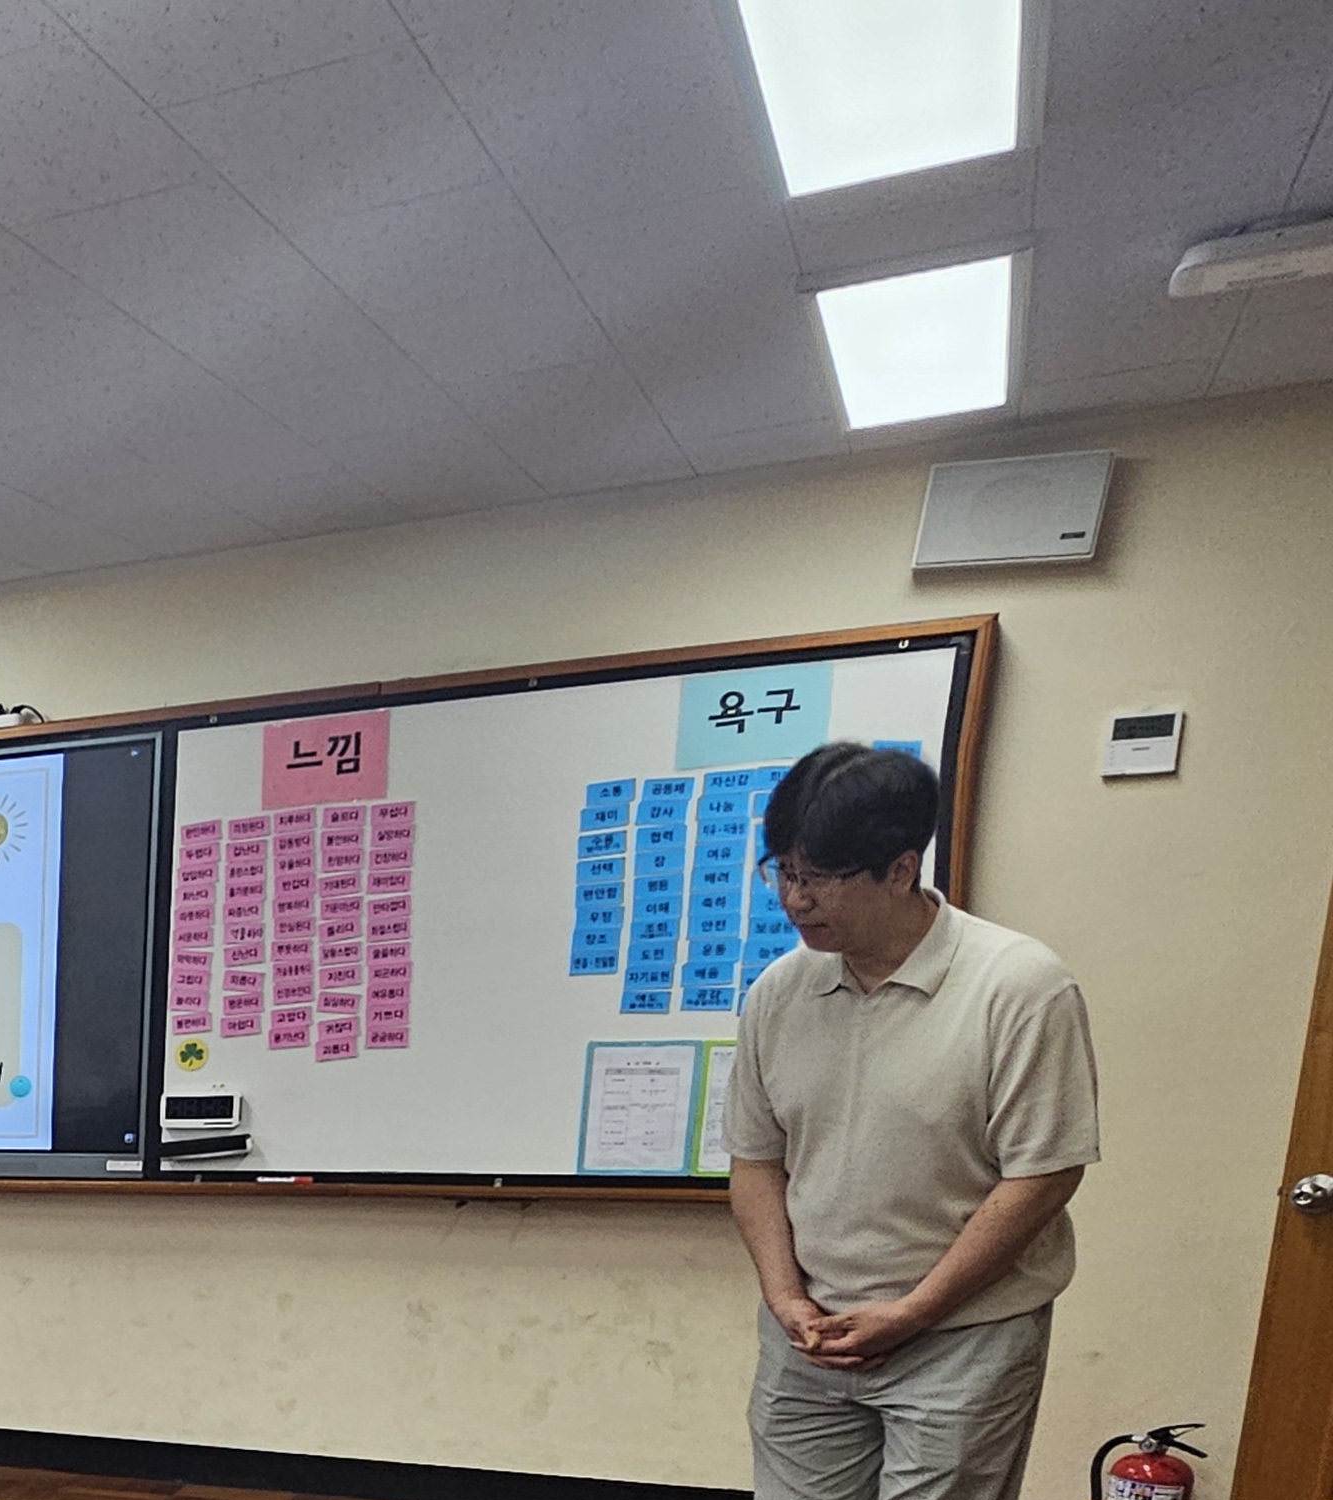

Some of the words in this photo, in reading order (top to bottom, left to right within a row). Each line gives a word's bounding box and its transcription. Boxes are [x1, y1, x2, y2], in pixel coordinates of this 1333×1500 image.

[708, 687, 801, 734] 욕구
[286, 731, 362, 776] 느낌
[710, 774, 749, 788] 자신감
[379, 806, 408, 819] 무섭다
[650, 806, 674, 819] 감사
[185, 846, 212, 860] 두렵다
[706, 846, 731, 861] 여유
[590, 862, 614, 875] 선택
[645, 901, 670, 915] 이해
[589, 910, 613, 924] 우정
[628, 970, 670, 983] 자기표현
[373, 1009, 404, 1021] 기쁘다
